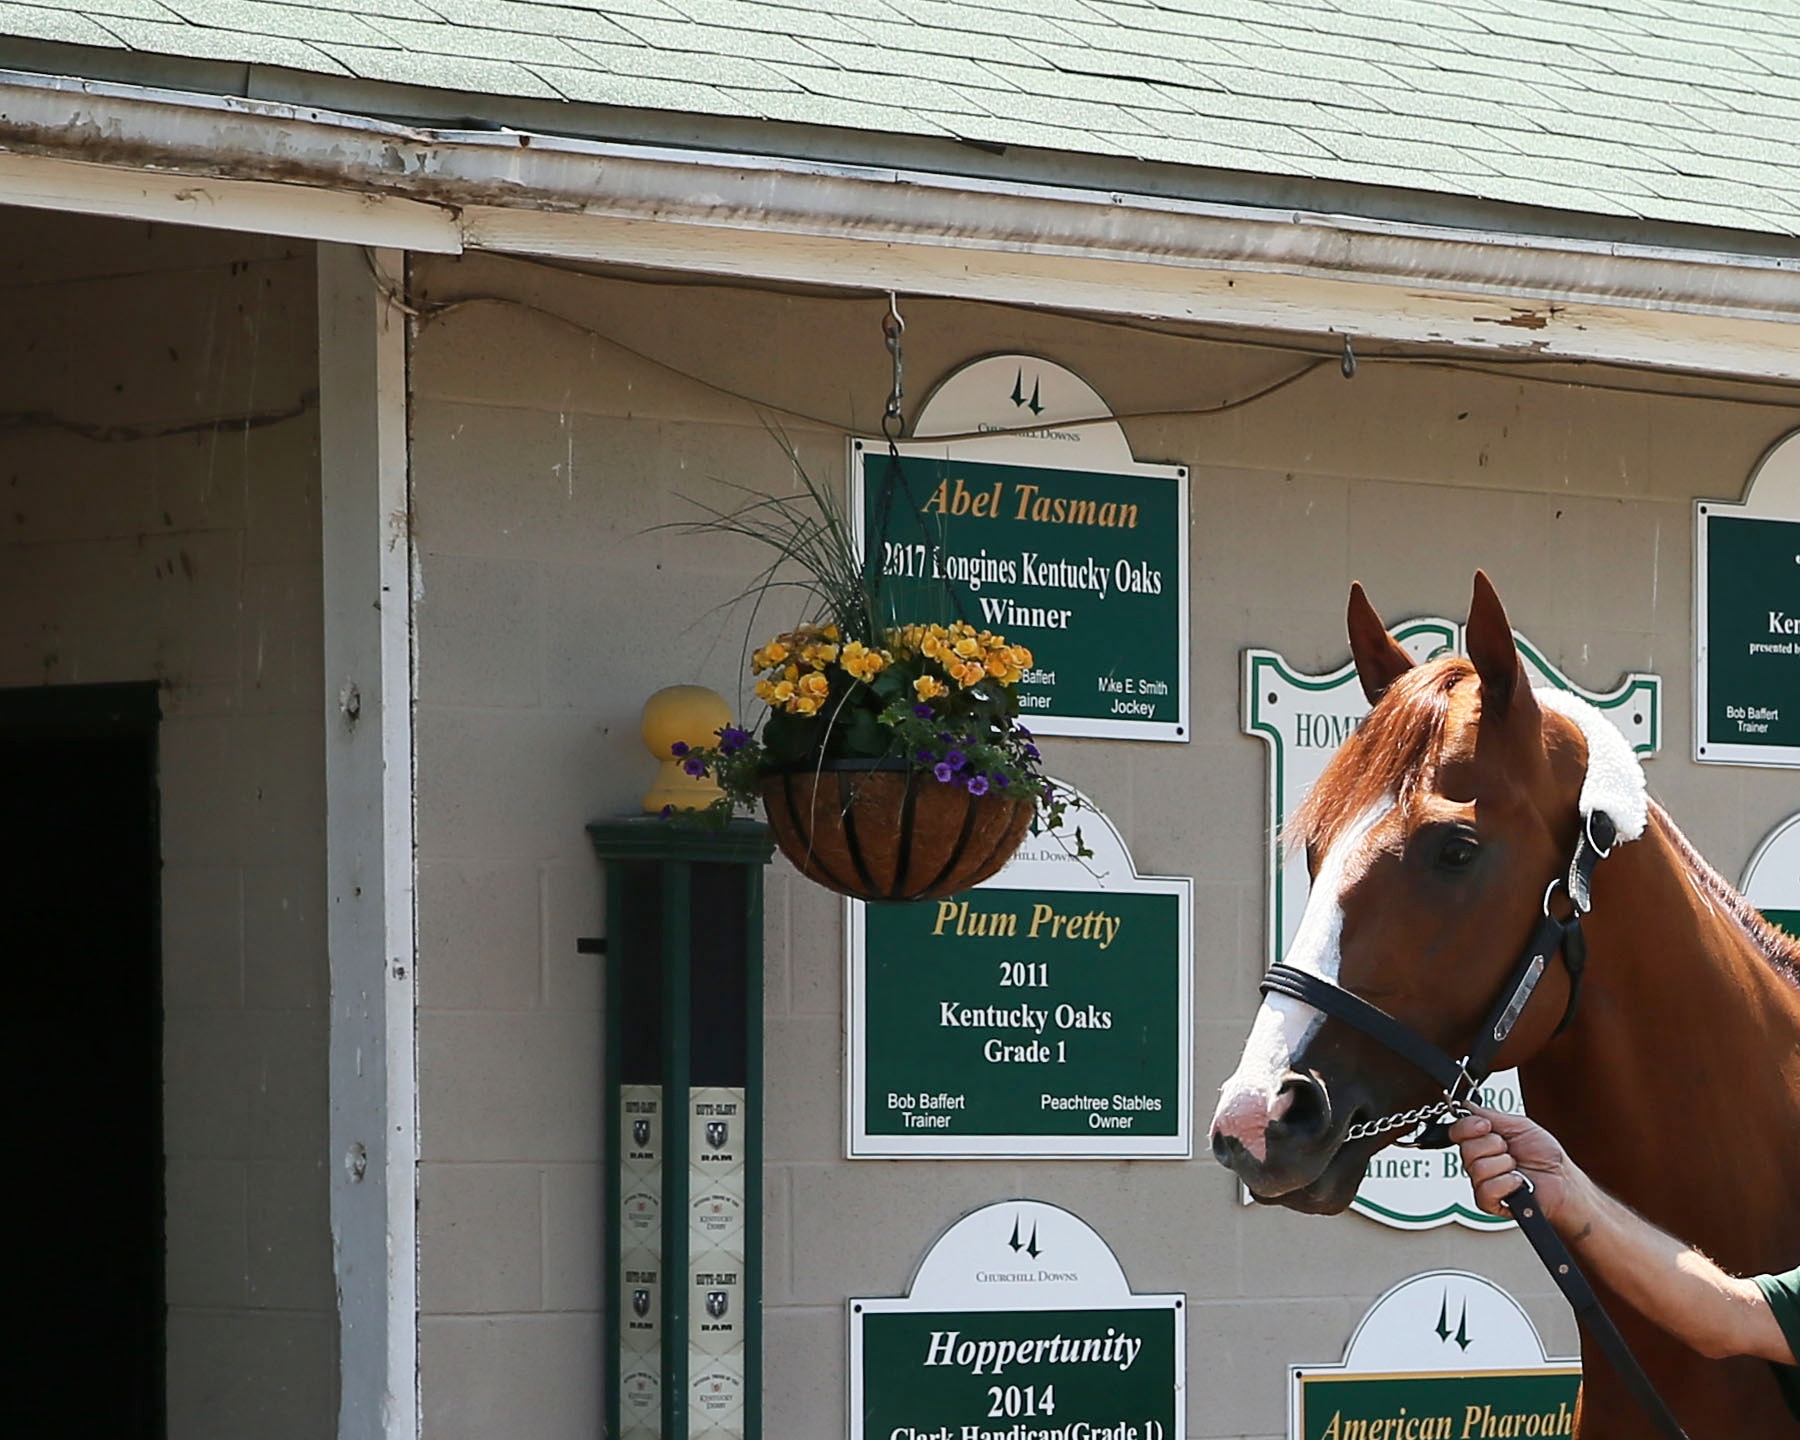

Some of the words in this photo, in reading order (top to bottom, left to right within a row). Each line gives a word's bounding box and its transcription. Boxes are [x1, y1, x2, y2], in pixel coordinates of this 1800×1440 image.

[921, 477, 1003, 518] Abel
[1015, 483, 1139, 529] Tasman
[882, 541, 926, 578] 2017
[931, 545, 1017, 592] Longines
[1021, 552, 1110, 600] Kentucky
[1114, 559, 1162, 595] Oaks
[979, 597, 1072, 629] Winner
[1749, 642, 1792, 658] presented
[1021, 669, 1056, 686] Baffert
[1098, 677, 1122, 693] Mike
[1124, 678, 1136, 694] E.
[1138, 679, 1168, 695] Smith
[1110, 698, 1156, 718] Jockey
[1726, 706, 1746, 719] Bob
[1747, 707, 1778, 721] Baffert
[1295, 713, 1363, 748] HOM
[1737, 721, 1769, 735] Trainer
[932, 900, 1017, 938] Plum
[1027, 904, 1121, 950] Pretty
[999, 961, 1048, 988] 2011
[940, 1002, 1048, 1034] Kentucky
[1055, 1004, 1112, 1030] Oaks
[984, 1039, 1051, 1063] Grade
[1056, 1041, 1066, 1063] 1
[887, 1093, 916, 1109] Bob
[919, 1093, 965, 1110] Baffert
[1041, 1094, 1108, 1111] Peachtree
[1112, 1094, 1162, 1111] Stables
[902, 1112, 951, 1128] Trainer
[1088, 1112, 1133, 1129] Owner
[975, 1270, 1036, 1283] CHURCHILL
[1037, 1270, 1078, 1283] DOWNS
[923, 1328, 1142, 1375] Hoppertunity
[987, 1385, 1056, 1418] 2014
[1460, 1403, 1573, 1440] Pharoah
